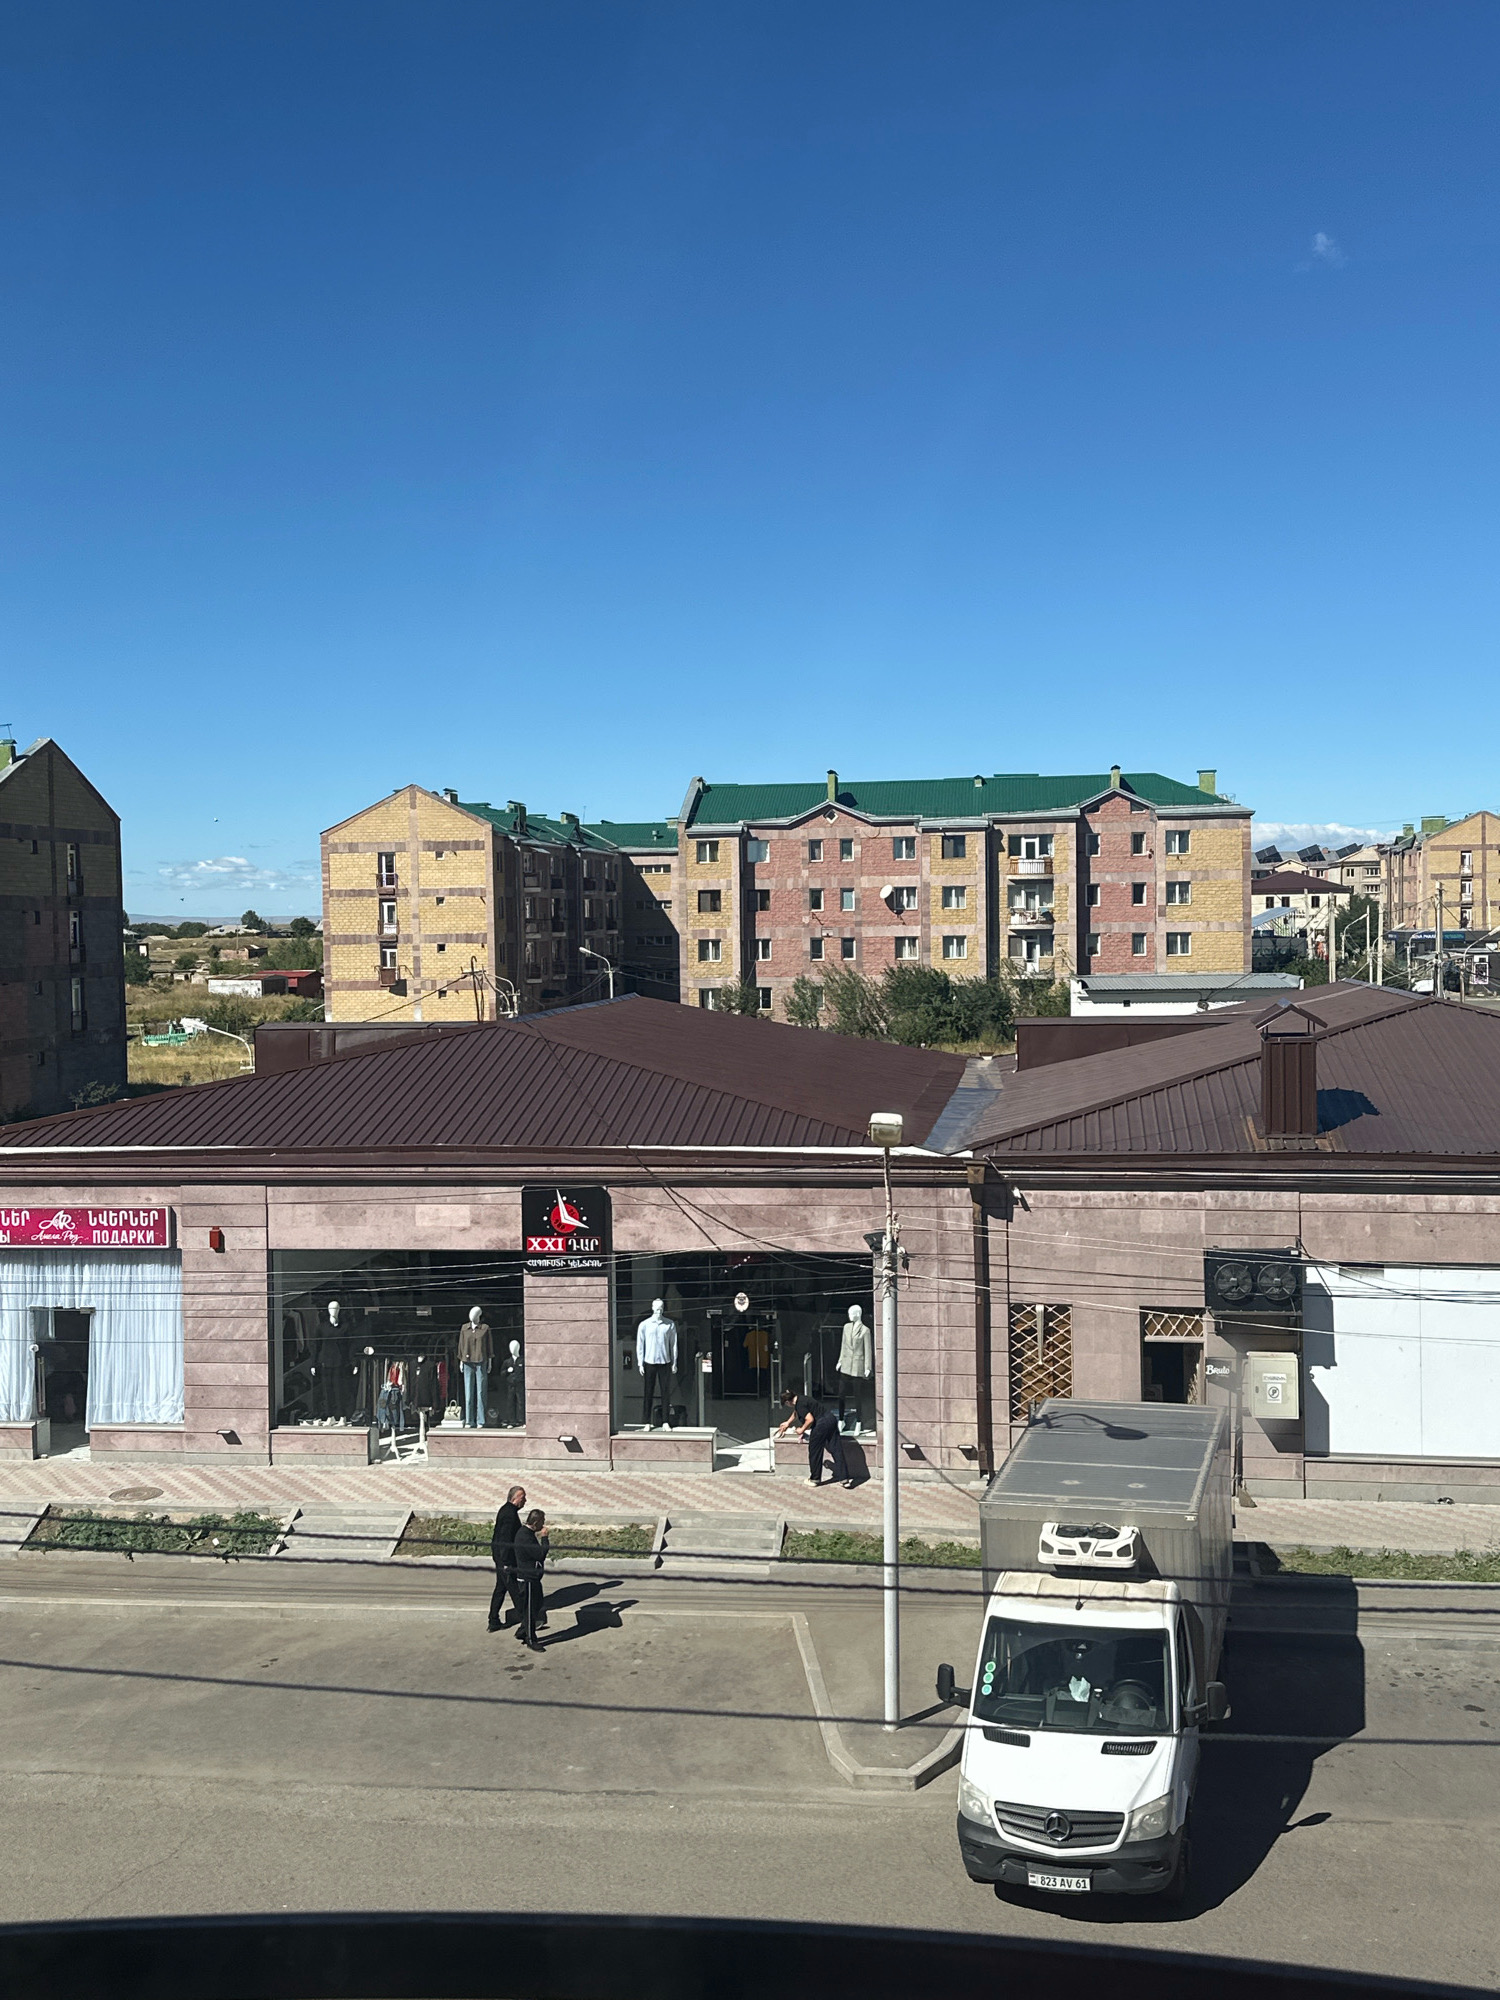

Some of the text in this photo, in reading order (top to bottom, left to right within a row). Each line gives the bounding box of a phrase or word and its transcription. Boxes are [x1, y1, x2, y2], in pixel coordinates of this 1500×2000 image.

[87, 1210, 159, 1227] ՆՎԵՐՆԵՐ
[92, 1229, 155, 1244] ПОДАРКИ
[527, 1237, 599, 1252] XXI ԴԱՐ
[1040, 1876, 1087, 1889] 823 AV 61
